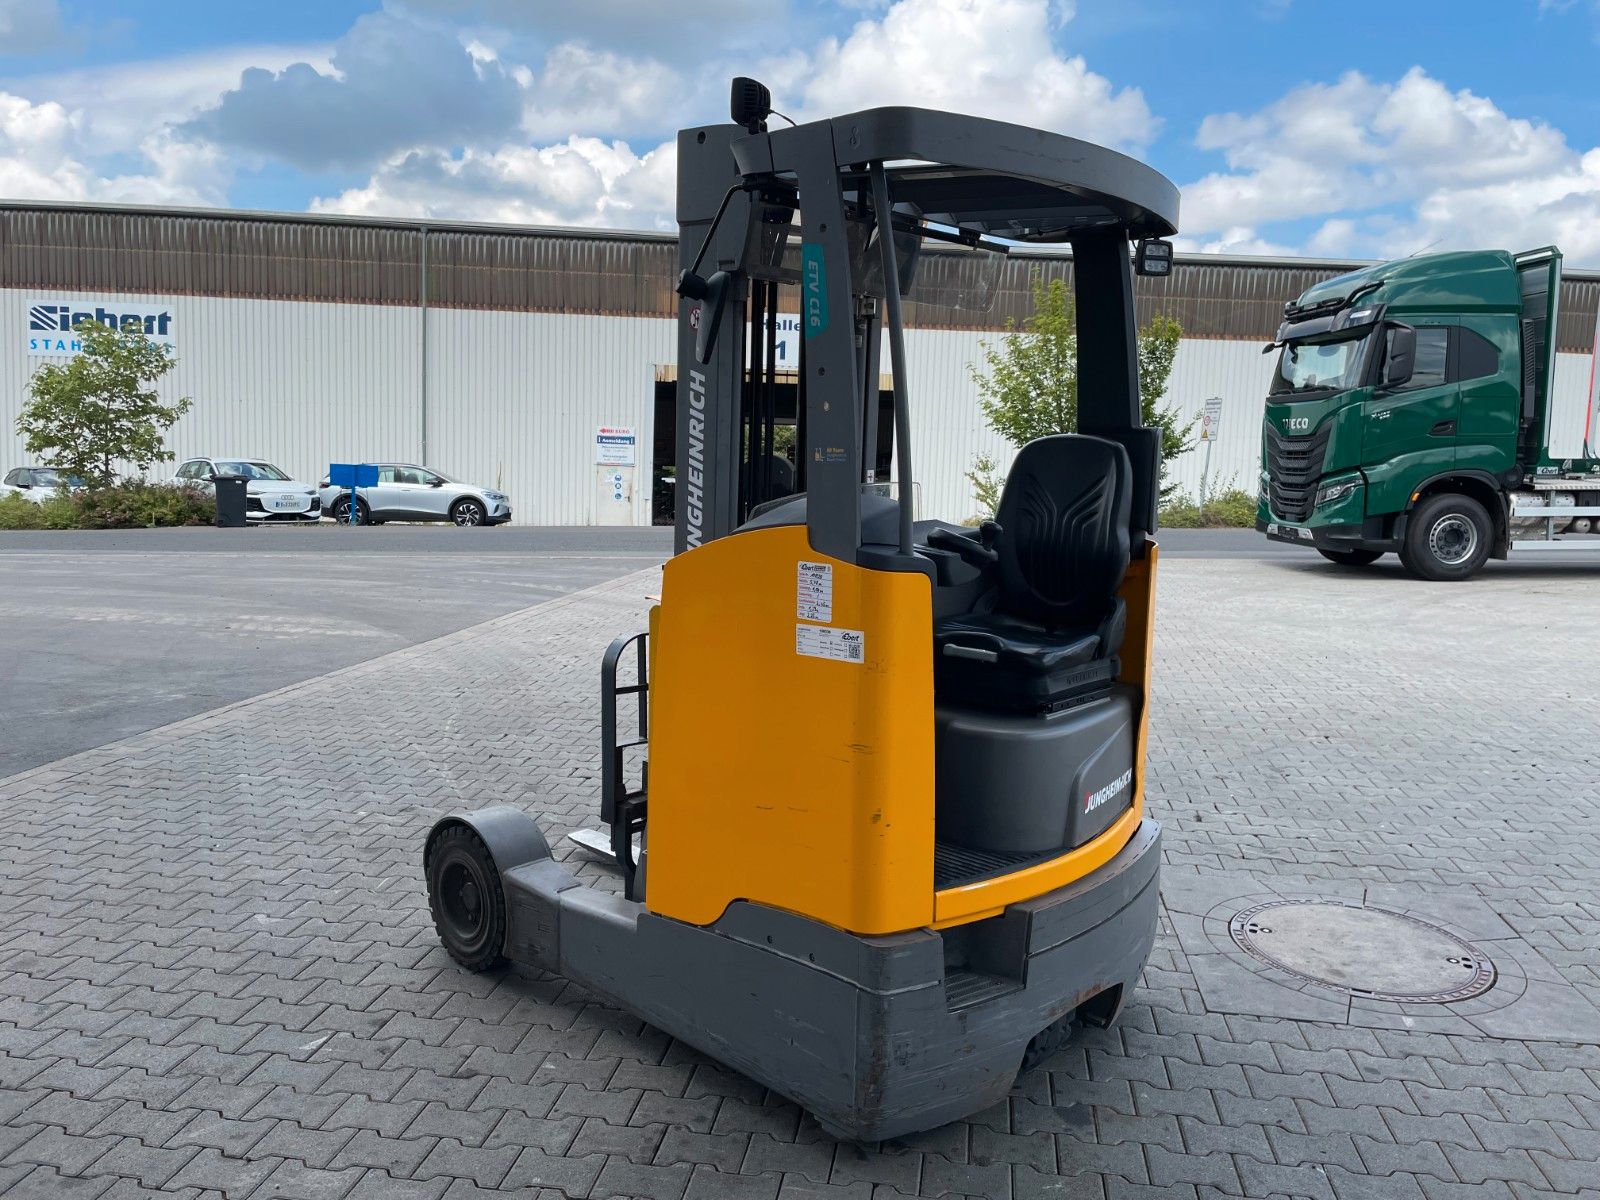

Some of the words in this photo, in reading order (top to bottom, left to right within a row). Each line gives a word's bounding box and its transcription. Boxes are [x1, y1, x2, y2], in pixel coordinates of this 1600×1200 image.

[808, 260, 820, 293] ETV
[810, 297, 821, 327] C16
[775, 340, 786, 361] 1
[686, 369, 707, 551] NGHEINRICH
